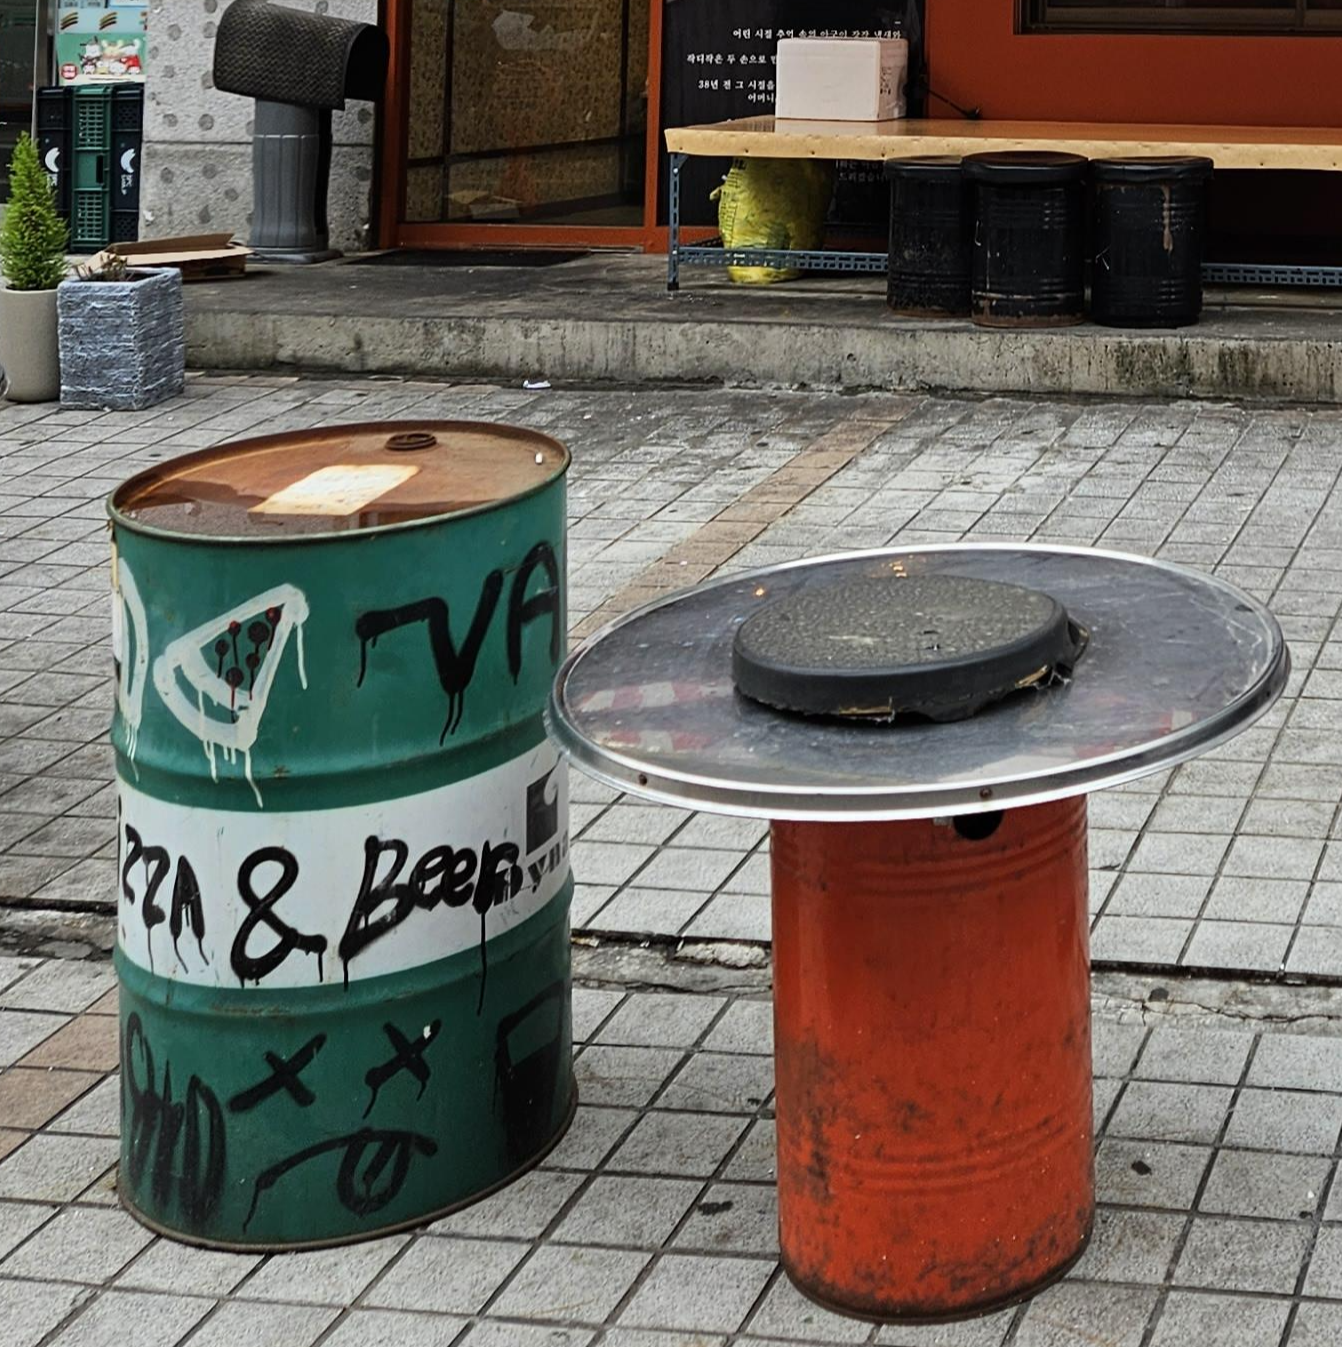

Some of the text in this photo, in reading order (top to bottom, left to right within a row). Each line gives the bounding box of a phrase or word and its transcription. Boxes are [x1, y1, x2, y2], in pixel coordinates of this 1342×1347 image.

[733, 28, 751, 39] 어린
[754, 28, 773, 39] 시절
[698, 79, 719, 90] 38년
[734, 79, 744, 90] 그
[230, 846, 328, 983] &
[339, 835, 520, 961] Beer
